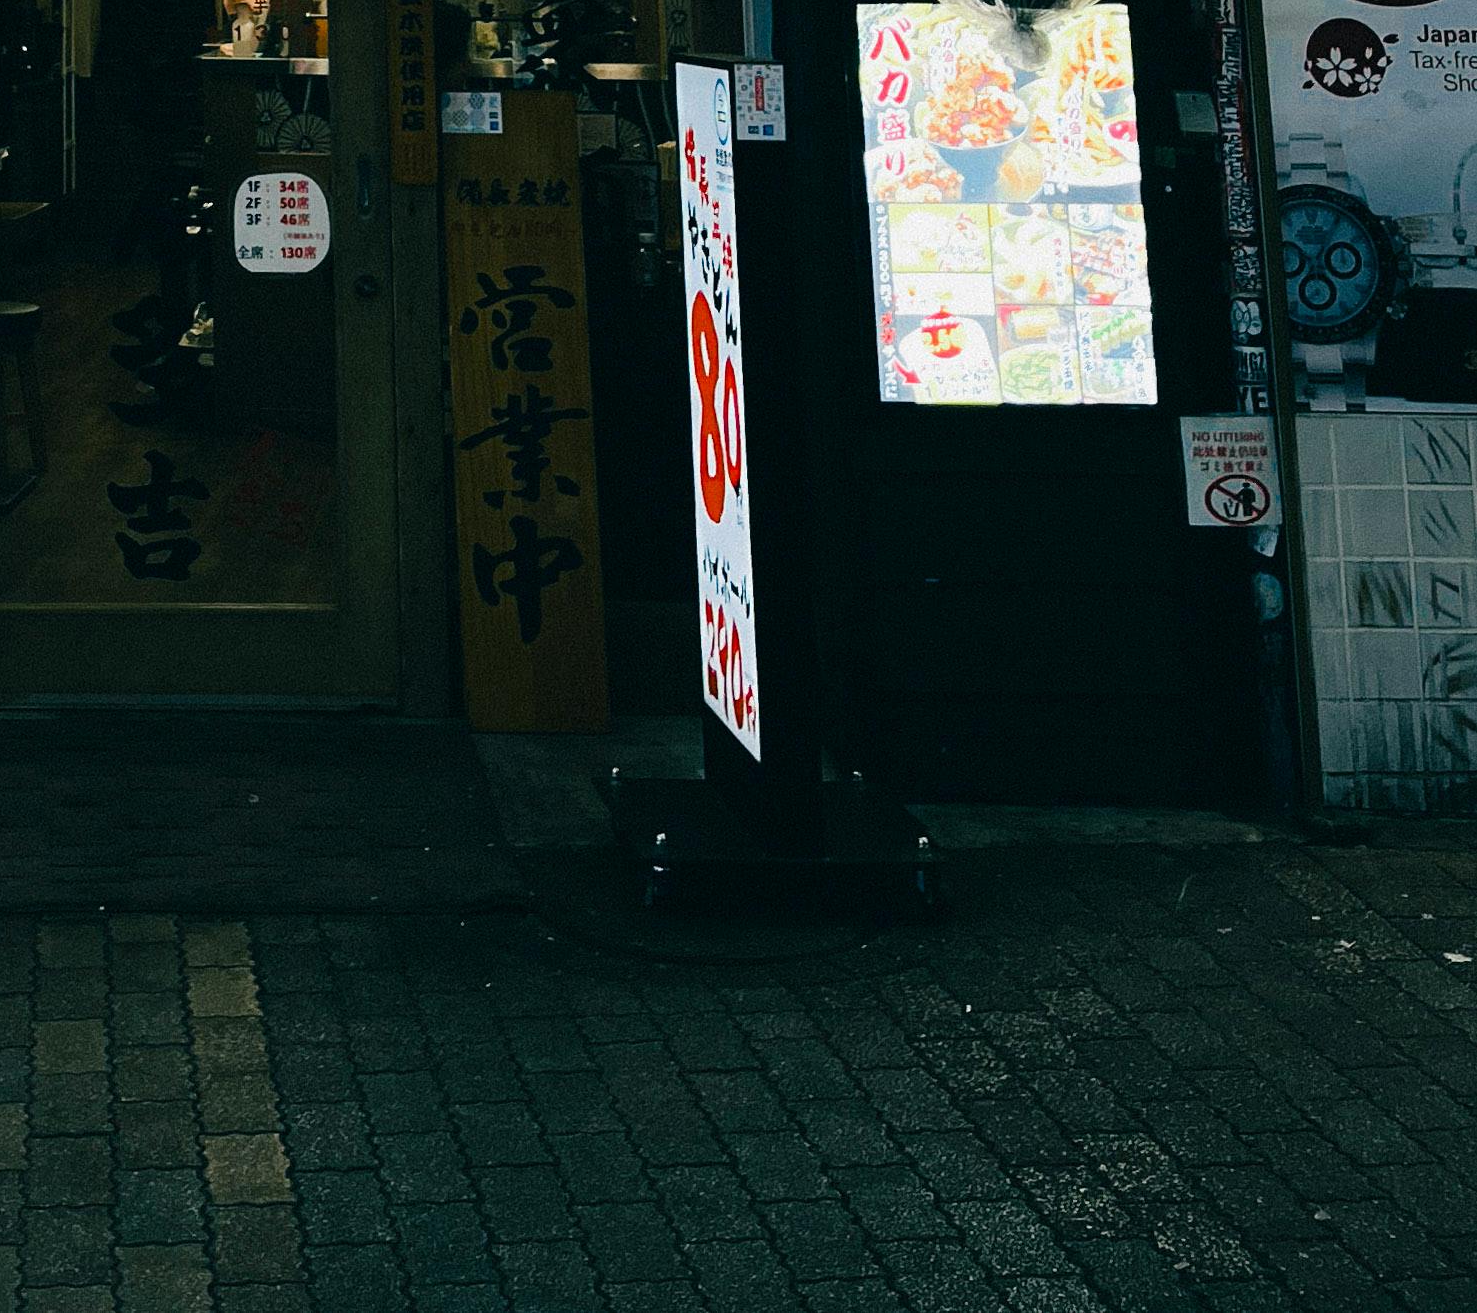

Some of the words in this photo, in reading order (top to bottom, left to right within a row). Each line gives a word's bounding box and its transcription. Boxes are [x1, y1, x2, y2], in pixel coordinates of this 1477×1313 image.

[869, 16, 912, 176] バカ盛り
[458, 265, 590, 645] 営業中
[1191, 431, 1211, 442] NO
